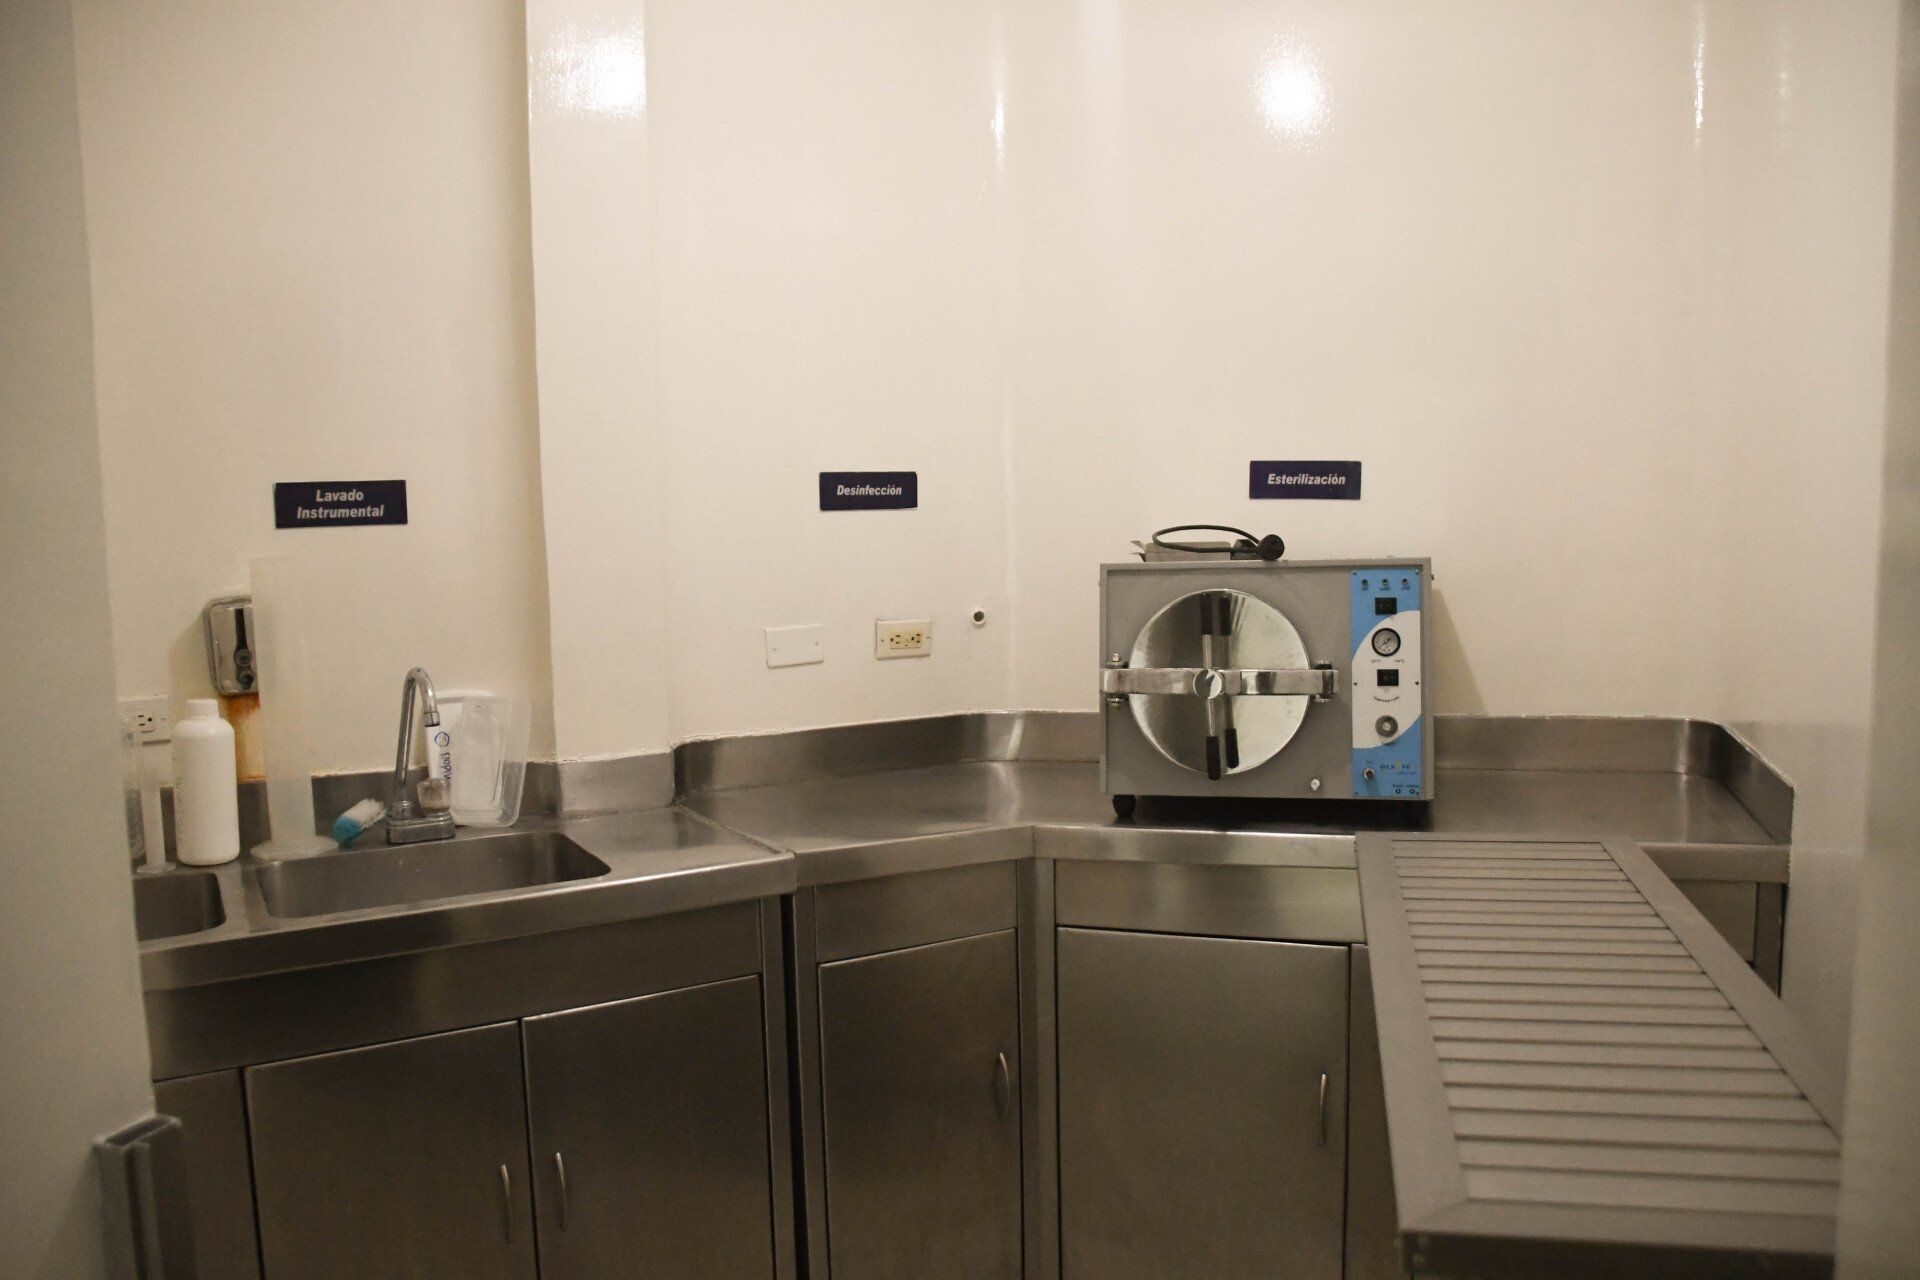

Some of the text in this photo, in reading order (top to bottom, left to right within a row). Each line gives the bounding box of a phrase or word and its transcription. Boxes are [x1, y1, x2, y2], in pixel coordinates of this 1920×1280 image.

[1268, 473, 1345, 485] Esterilización
[316, 489, 364, 502] Lavado
[837, 484, 902, 496] Desinfección
[297, 505, 385, 519] Instrumental
